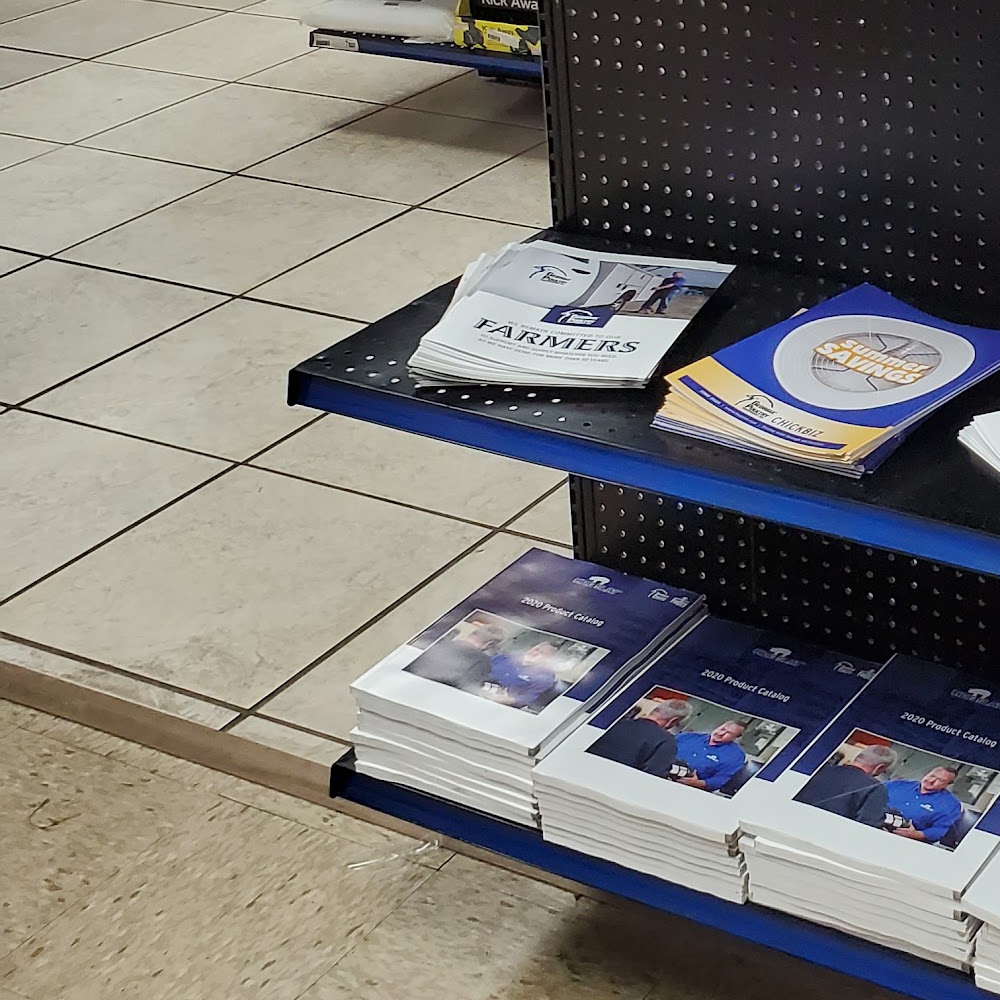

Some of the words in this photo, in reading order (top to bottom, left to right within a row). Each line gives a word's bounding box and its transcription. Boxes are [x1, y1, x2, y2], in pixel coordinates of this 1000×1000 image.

[473, 317, 641, 353] FARMERS
[815, 342, 925, 385] SAVINGS
[771, 417, 825, 437] CHICKBIZ
[520, 597, 543, 609] 2020
[542, 602, 574, 618] Product
[574, 613, 605, 627] Catalog
[700, 669, 725, 681] 2020
[723, 676, 758, 692] Product
[757, 687, 791, 703] Catalog
[900, 712, 926, 725] 2020
[925, 719, 962, 737] Product
[962, 730, 998, 748] Catalog
